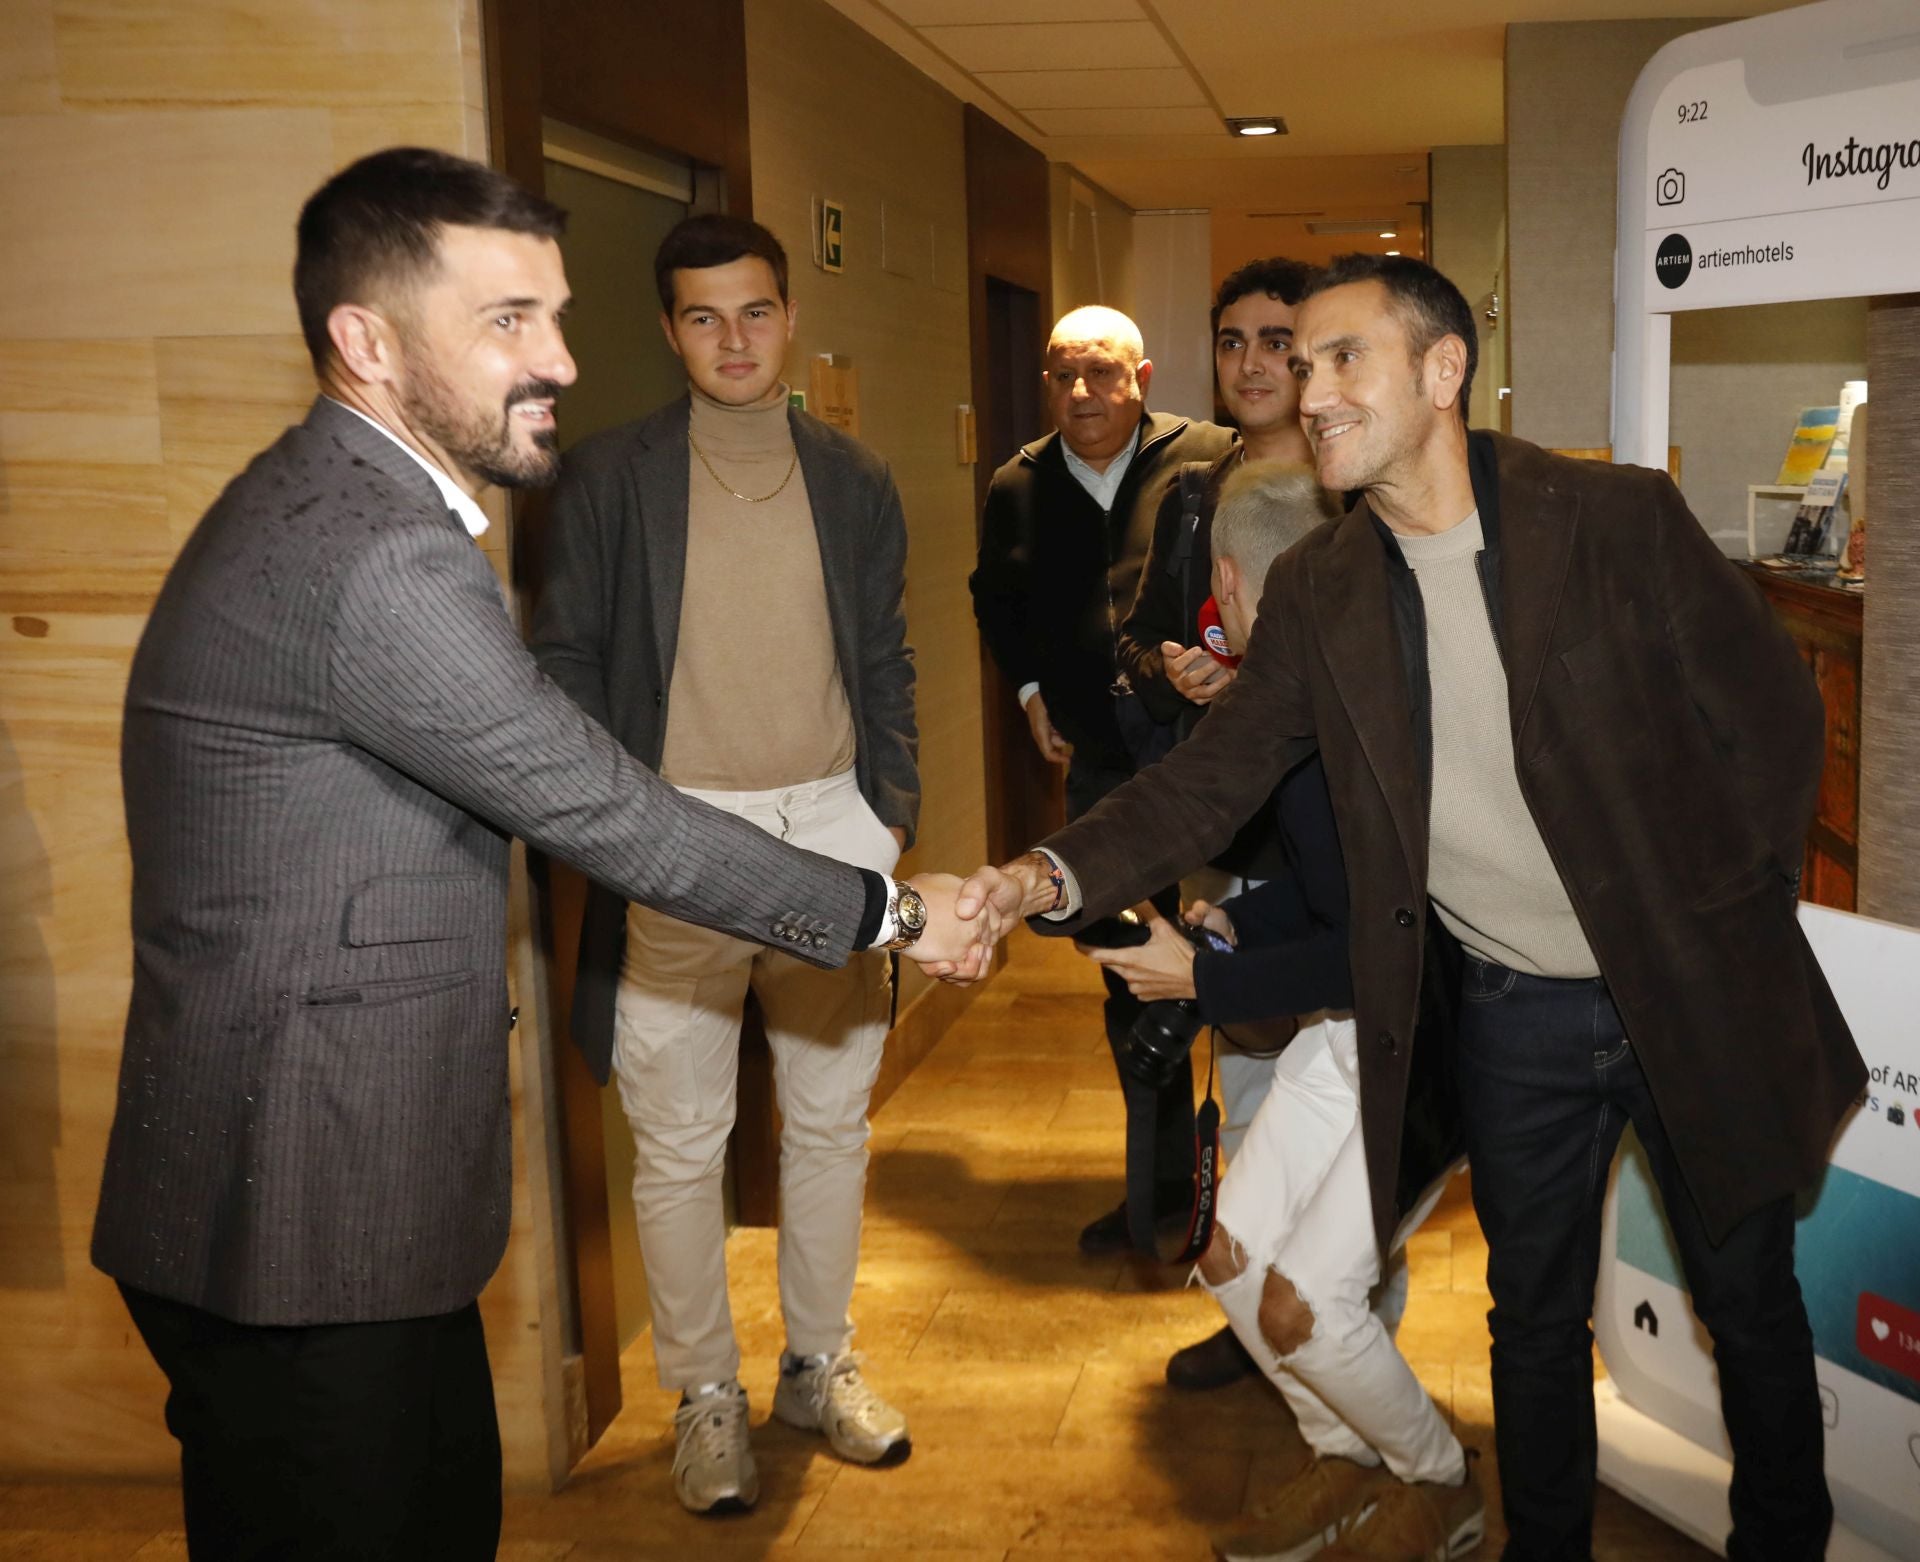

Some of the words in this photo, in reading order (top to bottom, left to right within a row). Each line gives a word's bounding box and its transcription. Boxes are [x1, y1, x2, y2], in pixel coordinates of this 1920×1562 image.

[1677, 100, 1708, 124] 9:22
[1657, 254, 1690, 267] ARTIEM
[1698, 241, 1794, 269] artiemhotels
[1871, 1065, 1890, 1085] of
[1893, 1070, 1920, 1095] AR
[1201, 1145, 1213, 1188] EOS
